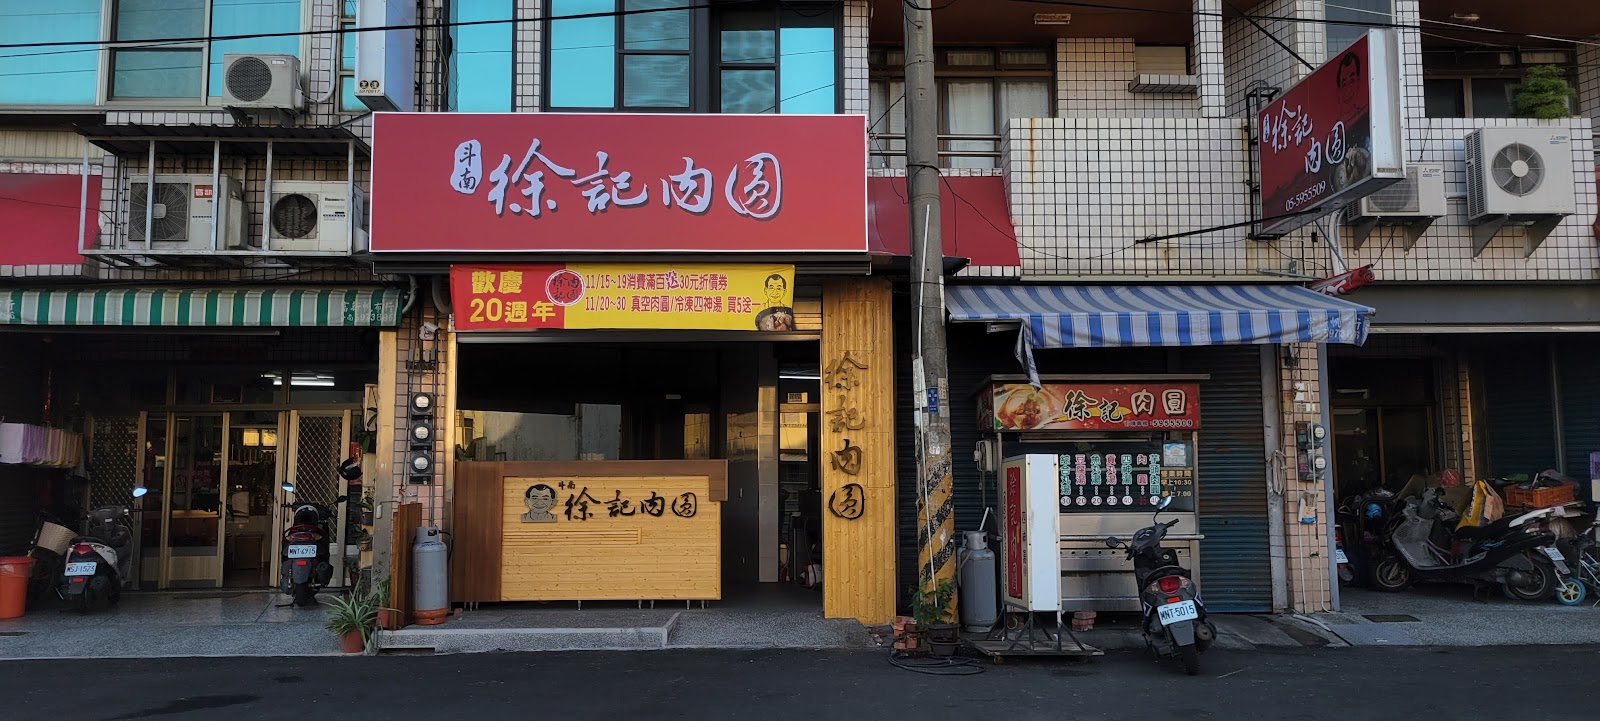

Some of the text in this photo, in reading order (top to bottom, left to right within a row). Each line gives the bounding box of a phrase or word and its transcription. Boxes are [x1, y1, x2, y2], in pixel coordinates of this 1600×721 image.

[458, 142, 477, 190] 斗南
[487, 138, 783, 220] 徐記肉圓
[1285, 180, 1326, 212] 05-5955509
[471, 270, 523, 294] 歡慶
[469, 297, 556, 323] 20週年
[824, 350, 869, 521] 徐記肉圓
[558, 480, 576, 490] 斗南
[564, 486, 698, 521] 徐記肉圓
[1076, 496, 1087, 505] 20
[1091, 496, 1102, 505] 20
[1107, 496, 1118, 505] 20
[1160, 604, 1195, 621] MNT-5015
